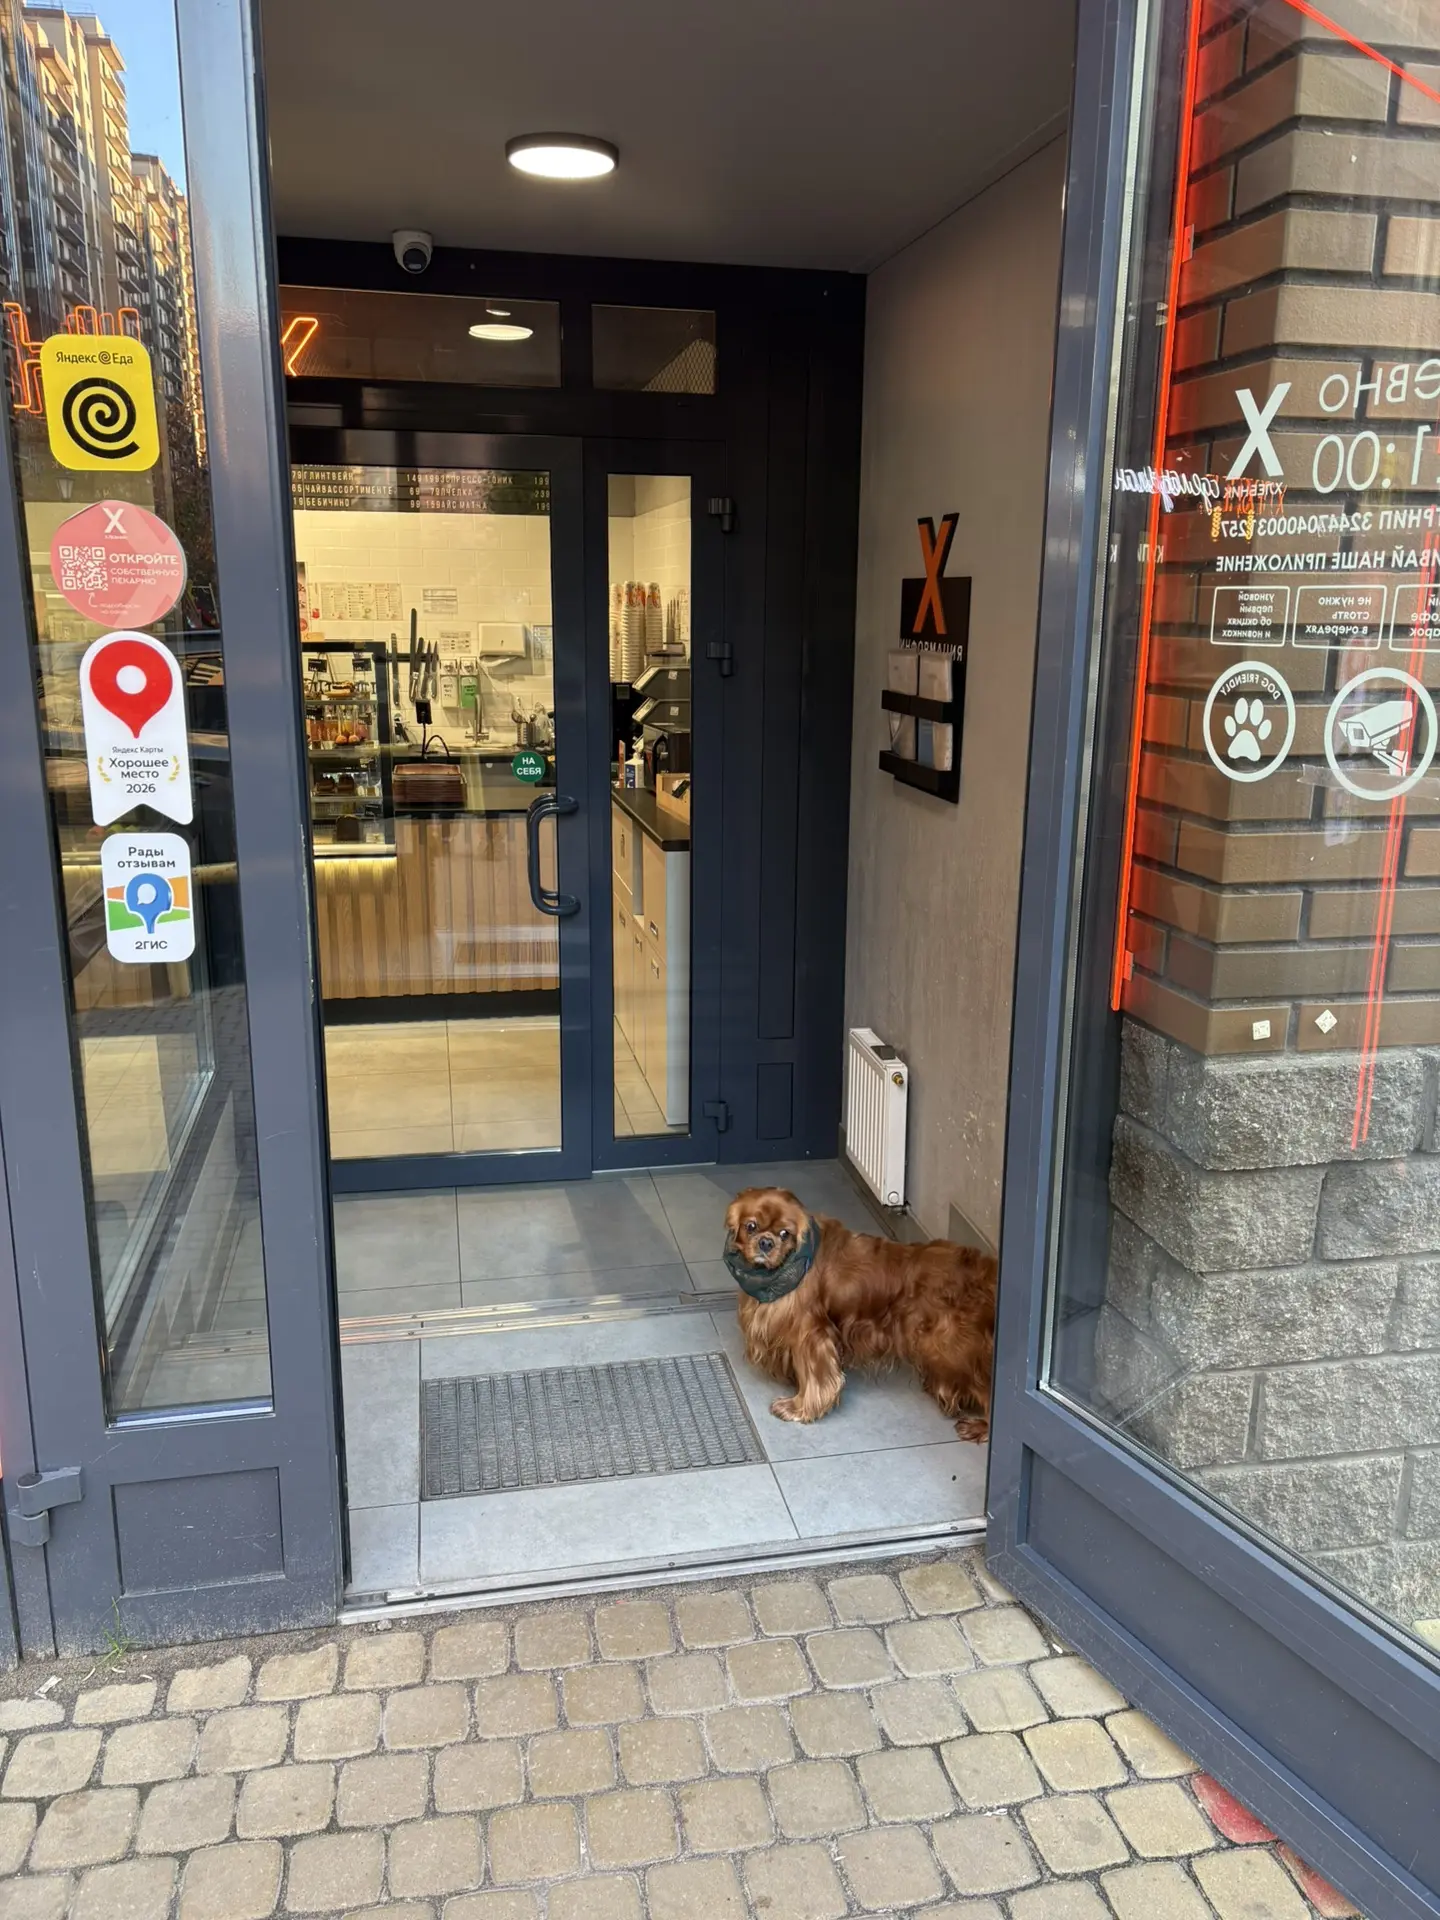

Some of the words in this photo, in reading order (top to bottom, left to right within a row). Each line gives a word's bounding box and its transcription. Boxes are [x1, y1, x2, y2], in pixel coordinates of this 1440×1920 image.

[56, 351, 98, 364] Яндекс
[112, 353, 134, 365] Еда
[303, 470, 354, 481] ГЛИНТВЕЙН
[305, 497, 350, 507] БЕБИЧИНО
[109, 552, 179, 565] ОТКРОЙТЕ
[110, 568, 180, 577] СОБСТВЕННУЮ
[111, 577, 157, 585] ПЕКАРНЮ
[112, 746, 138, 755] Яндекс
[139, 747, 164, 755] Карты
[109, 757, 169, 770] Хорошее
[522, 757, 536, 765] НА
[121, 770, 160, 779] место
[516, 767, 542, 776] СЕБЯ
[126, 784, 156, 793] 2026
[128, 847, 164, 858] Рады
[117, 860, 176, 868] отзывам
[135, 941, 168, 950] 2ГИС
